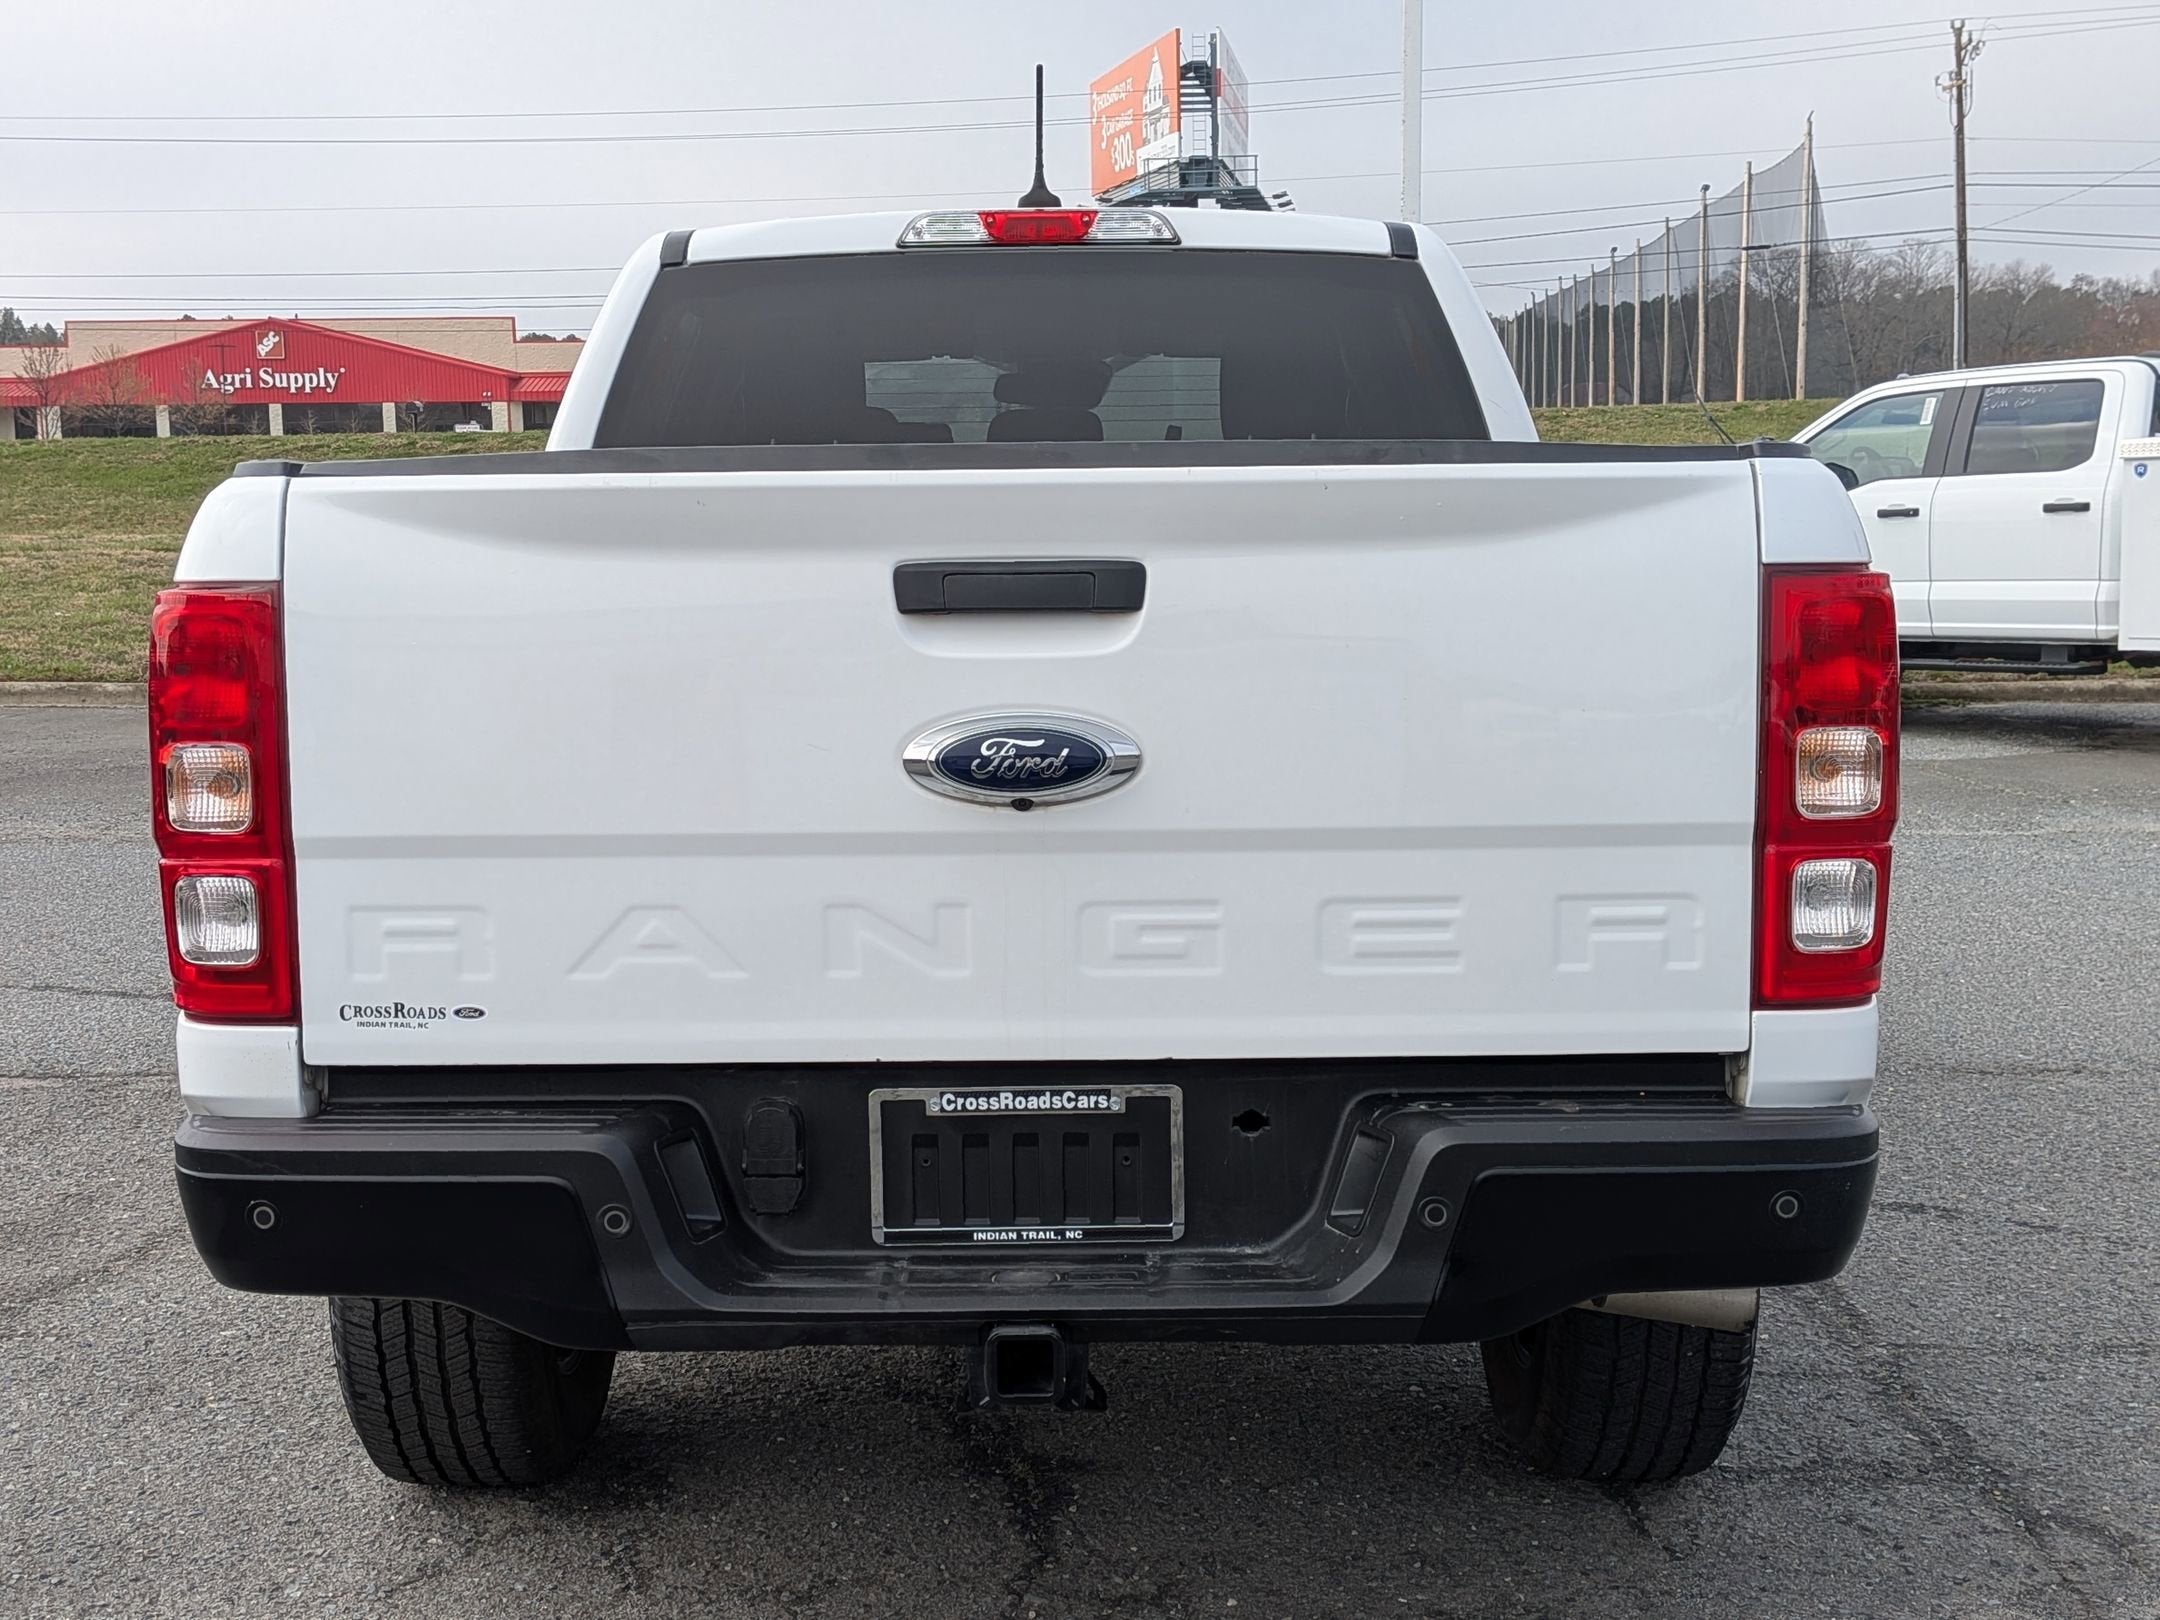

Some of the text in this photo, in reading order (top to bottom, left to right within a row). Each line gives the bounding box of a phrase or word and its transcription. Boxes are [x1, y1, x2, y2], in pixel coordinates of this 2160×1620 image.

[257, 330, 280, 357] ASC
[201, 367, 339, 394] Agri Supply
[970, 737, 1070, 780] Ford
[344, 892, 1704, 982] RANGER
[389, 1021, 416, 1030] TRAIL,
[941, 1091, 1109, 1112] CrossRoadsCars
[973, 1229, 1083, 1241] INDIAN TRAIL, NC
